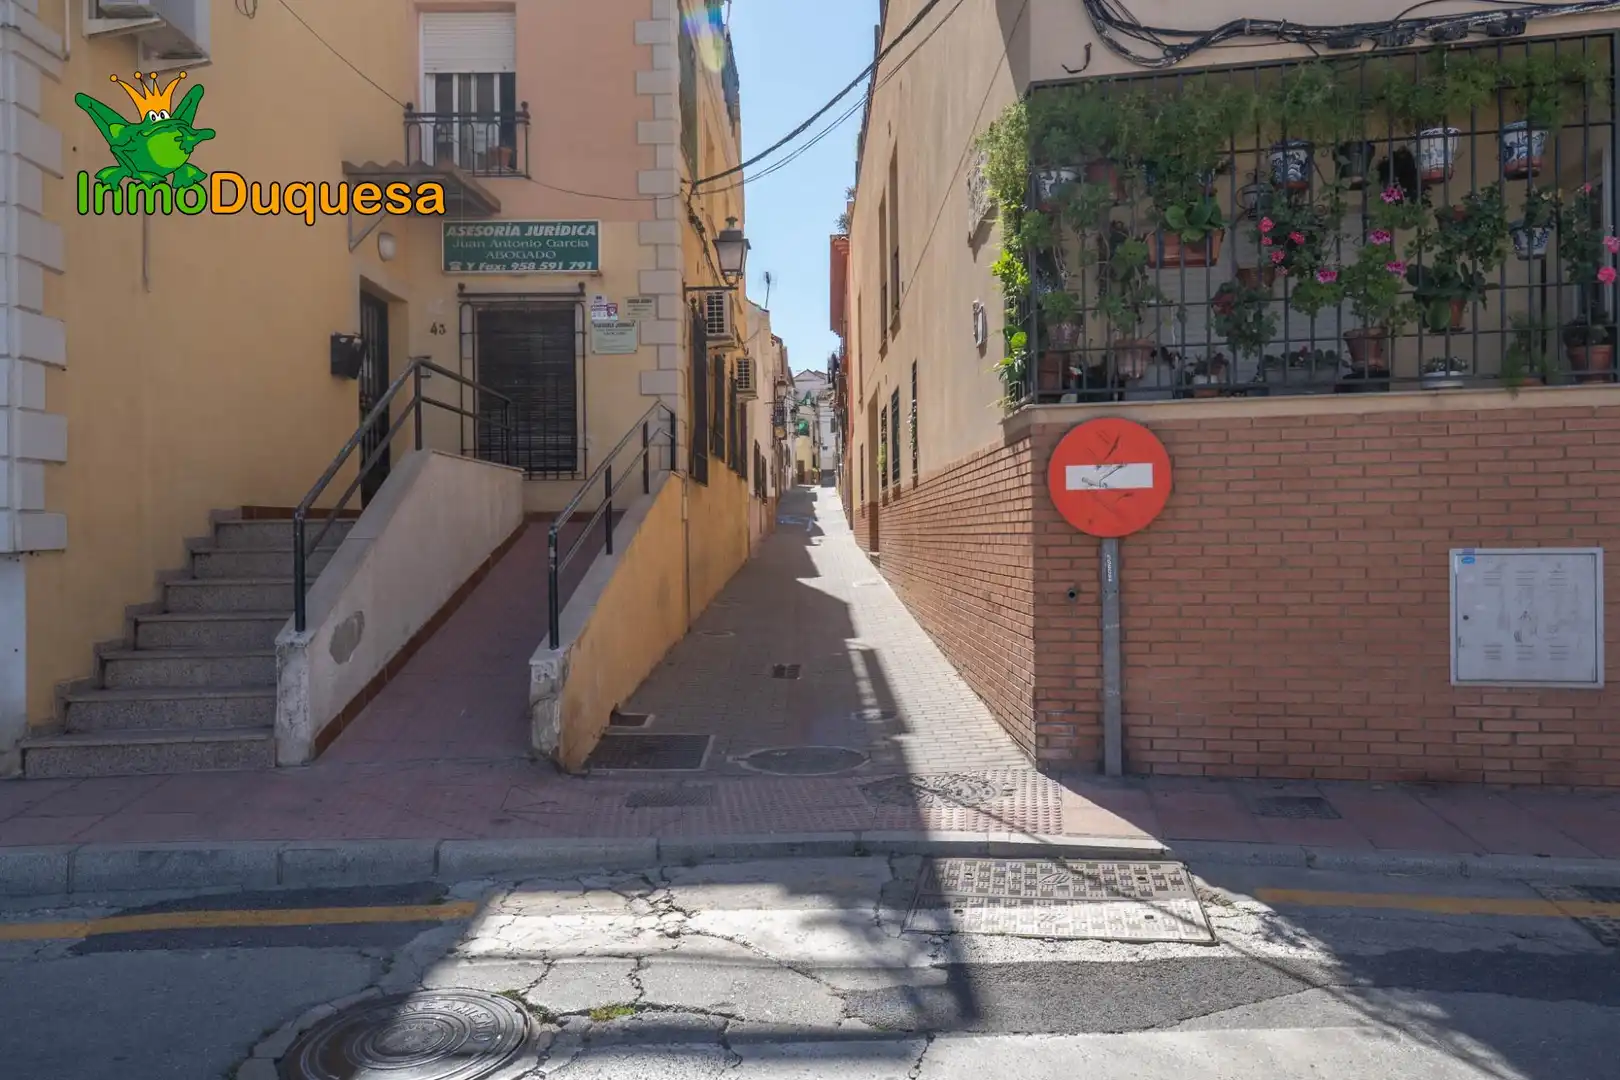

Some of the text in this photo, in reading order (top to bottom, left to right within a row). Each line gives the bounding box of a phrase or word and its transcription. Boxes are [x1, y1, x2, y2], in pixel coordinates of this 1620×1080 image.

[524, 222, 596, 236] JURÍDICA
[452, 238, 486, 248] Juan
[490, 239, 542, 248] Antonio
[485, 250, 556, 260] ABOGADO
[511, 261, 536, 271] 958
[538, 261, 564, 270] 591
[568, 261, 593, 270] 791
